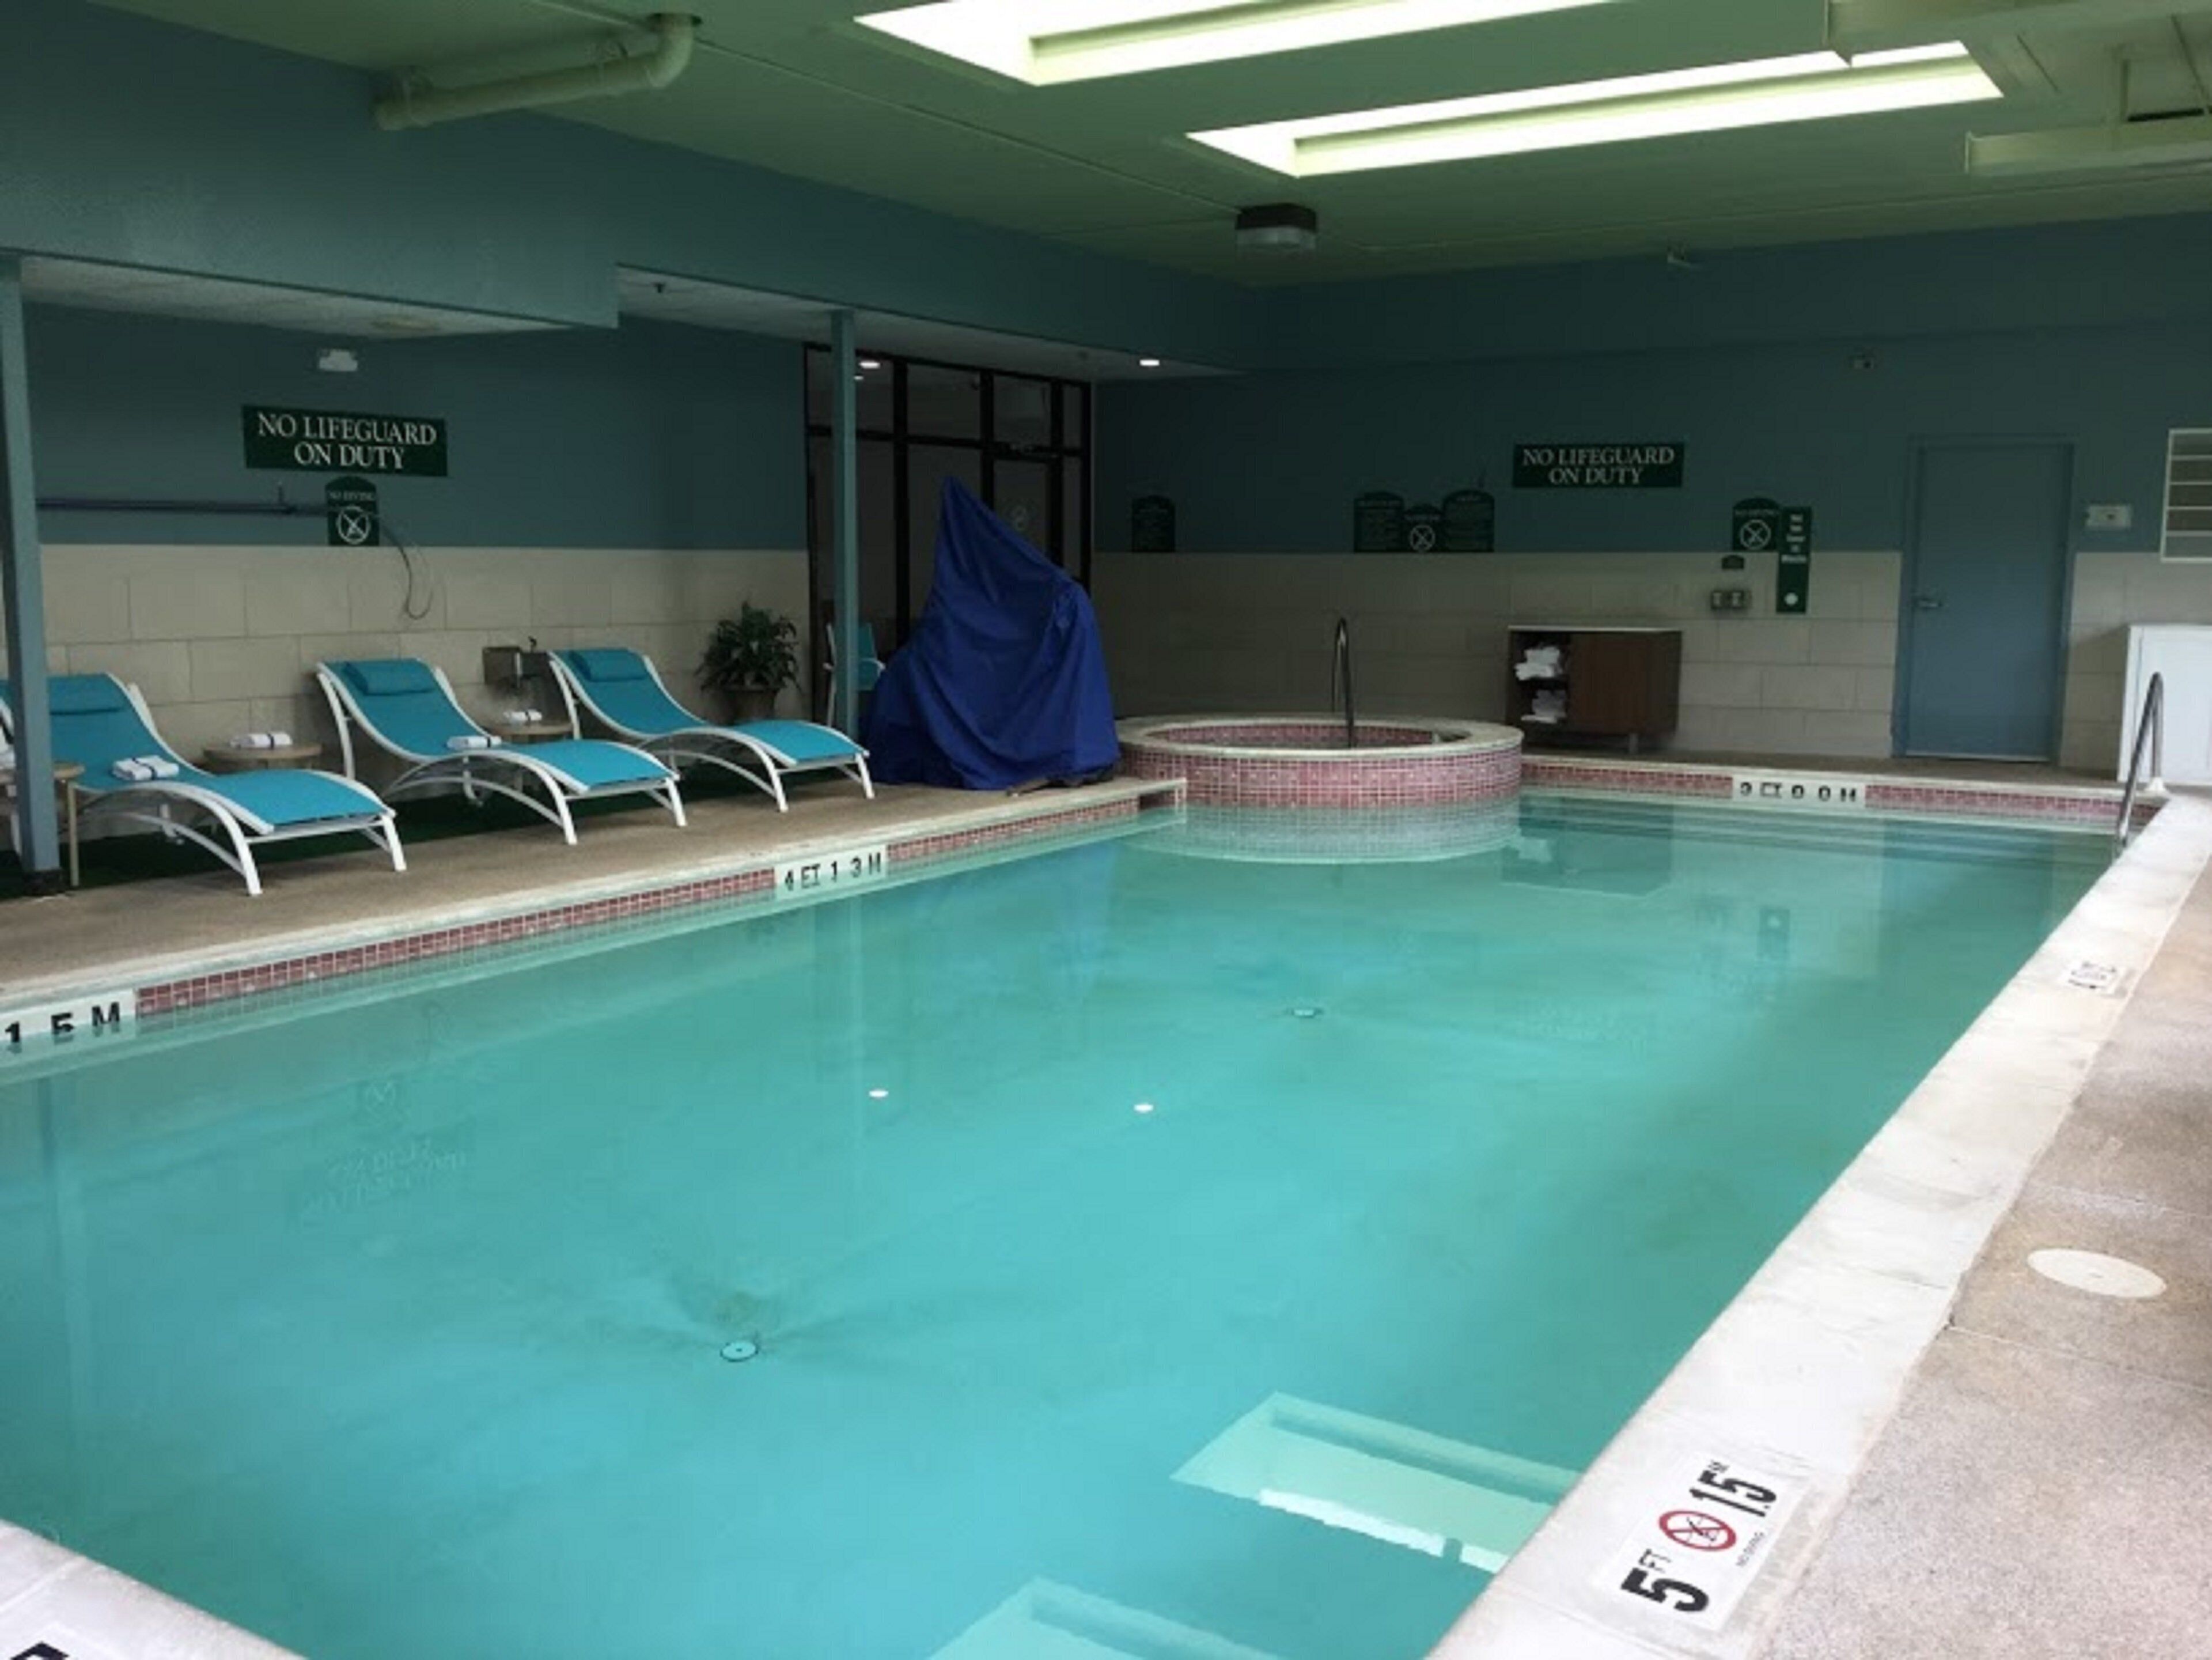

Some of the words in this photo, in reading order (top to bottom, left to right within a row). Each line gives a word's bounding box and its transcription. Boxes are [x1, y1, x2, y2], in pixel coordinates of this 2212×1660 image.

[257, 411, 296, 438] NO
[303, 416, 437, 446] LIFEGUARD
[294, 441, 332, 465] ON
[339, 444, 405, 469] DUTY
[1522, 448, 1553, 466] NO
[1558, 447, 1675, 466] LIFEGUARD
[1548, 467, 1580, 485] ON
[1586, 467, 1643, 485] DUTY
[92, 1001, 120, 1027] M
